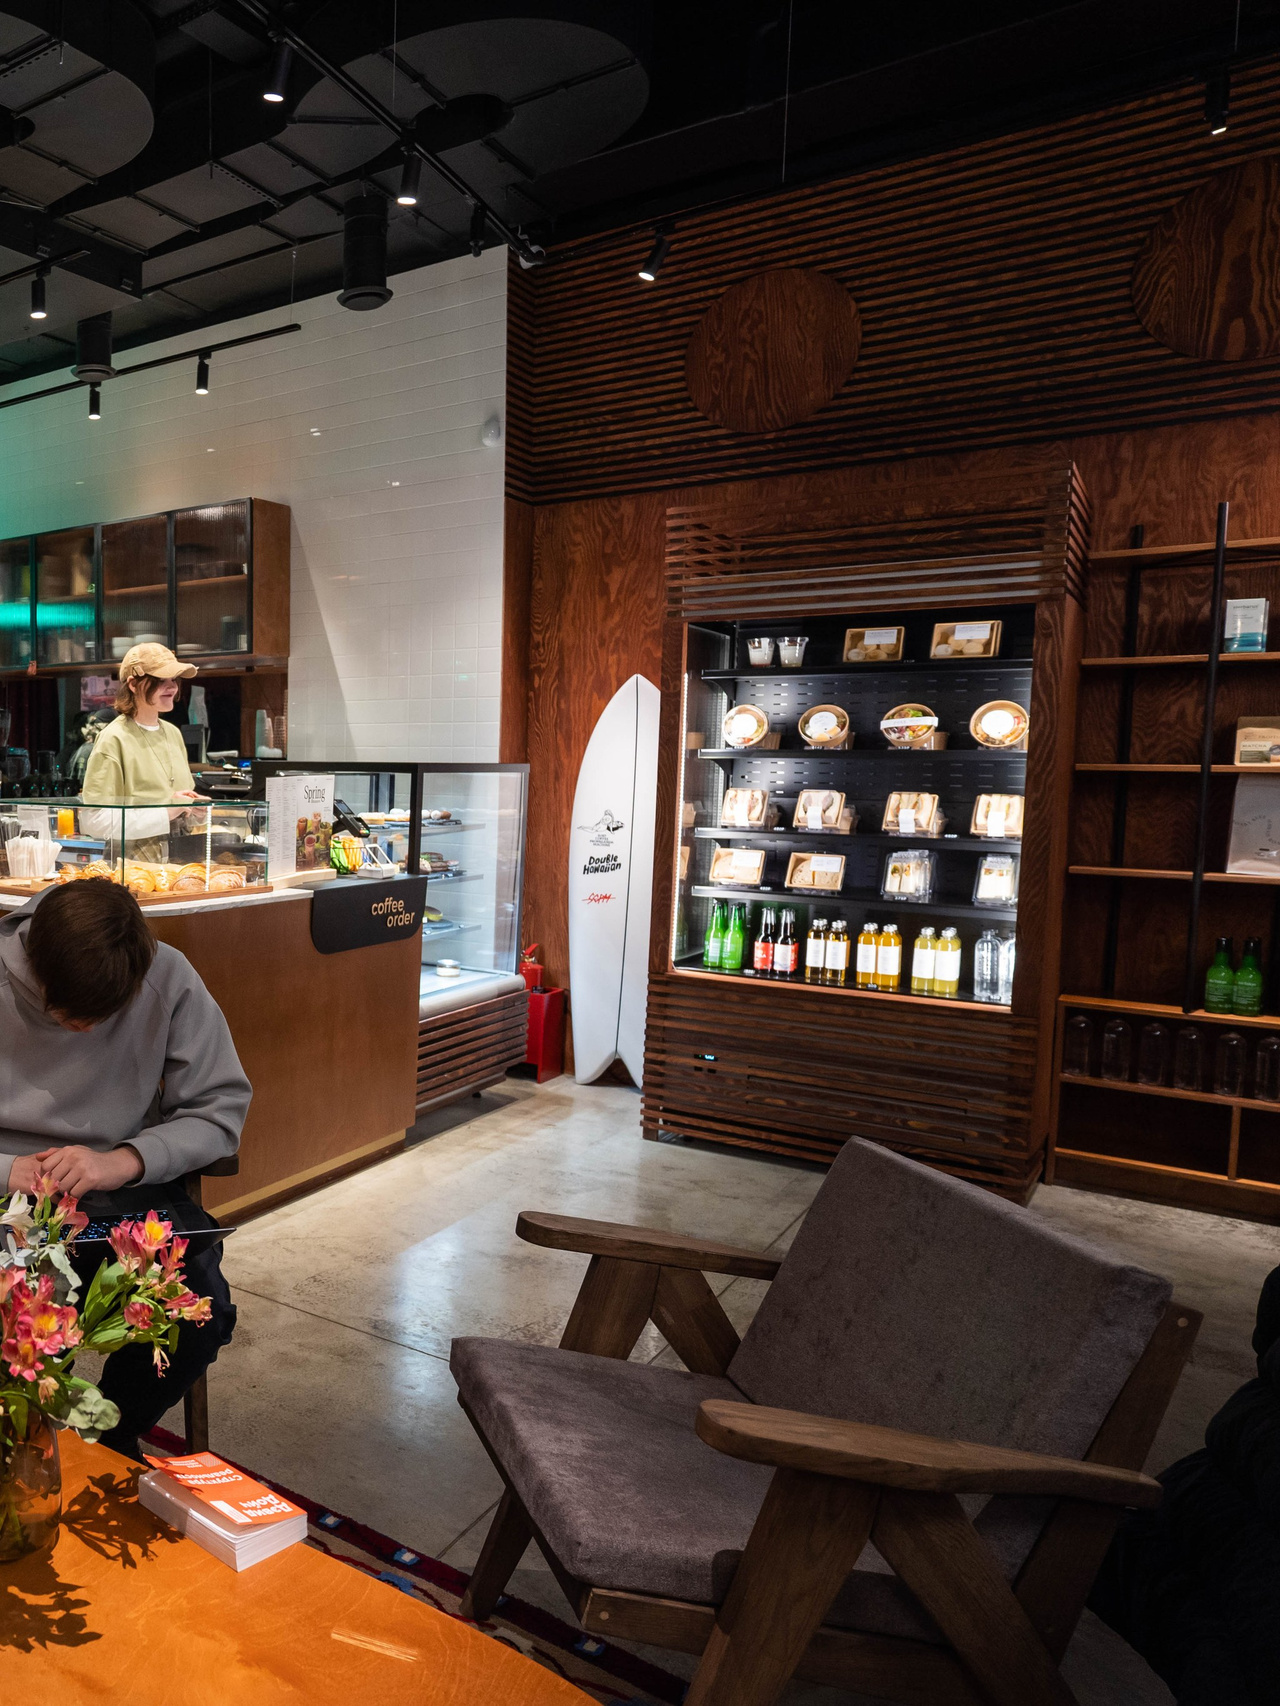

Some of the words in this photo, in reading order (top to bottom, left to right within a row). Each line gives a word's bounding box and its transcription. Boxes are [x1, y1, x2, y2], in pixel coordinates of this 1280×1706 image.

[303, 785, 326, 803] Spring
[371, 896, 405, 916] coffee
[386, 910, 416, 928] order
[187, 1474, 243, 1485] Структура
[239, 1493, 281, 1508] Дойч
[242, 1501, 294, 1517] Дэвид
